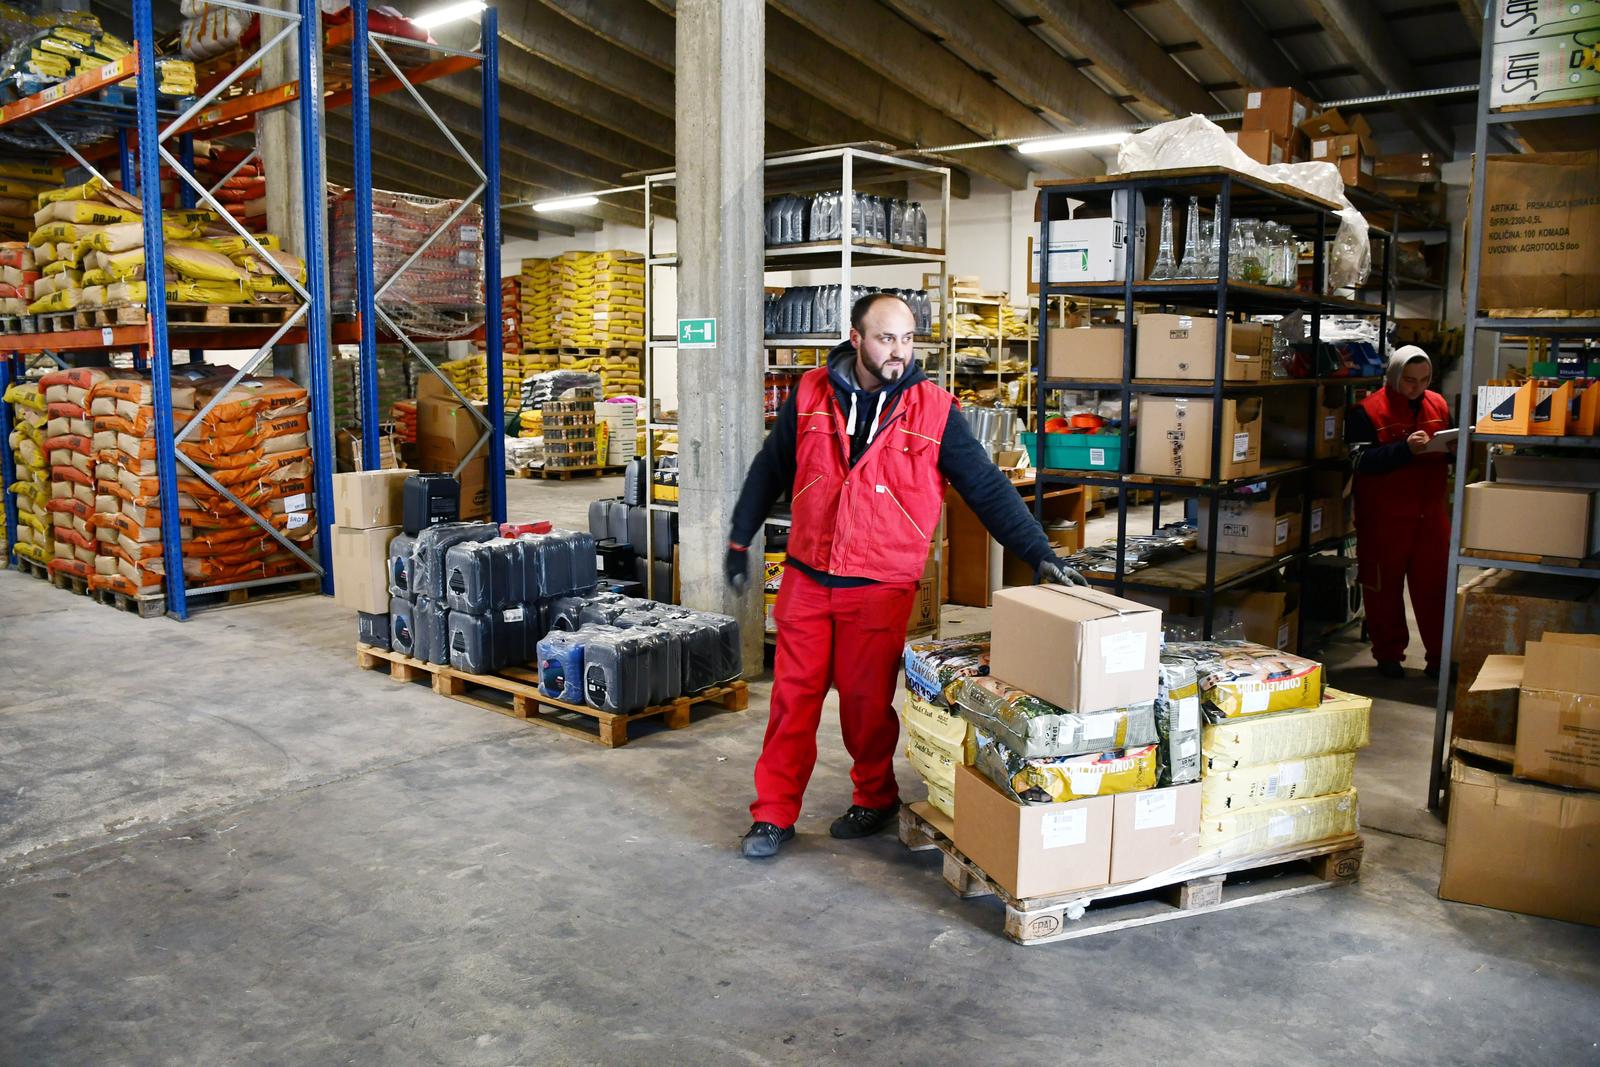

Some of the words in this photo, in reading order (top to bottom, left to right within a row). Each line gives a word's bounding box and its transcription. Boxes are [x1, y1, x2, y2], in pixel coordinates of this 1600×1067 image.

[1501, 51, 1540, 93] SANI
[1524, 230, 1536, 238] 100
[1538, 227, 1570, 237] KOMADA
[1520, 242, 1565, 252] AGROTOOLS
[271, 420, 299, 431] krmiva
[1032, 919, 1055, 934] EPAL
